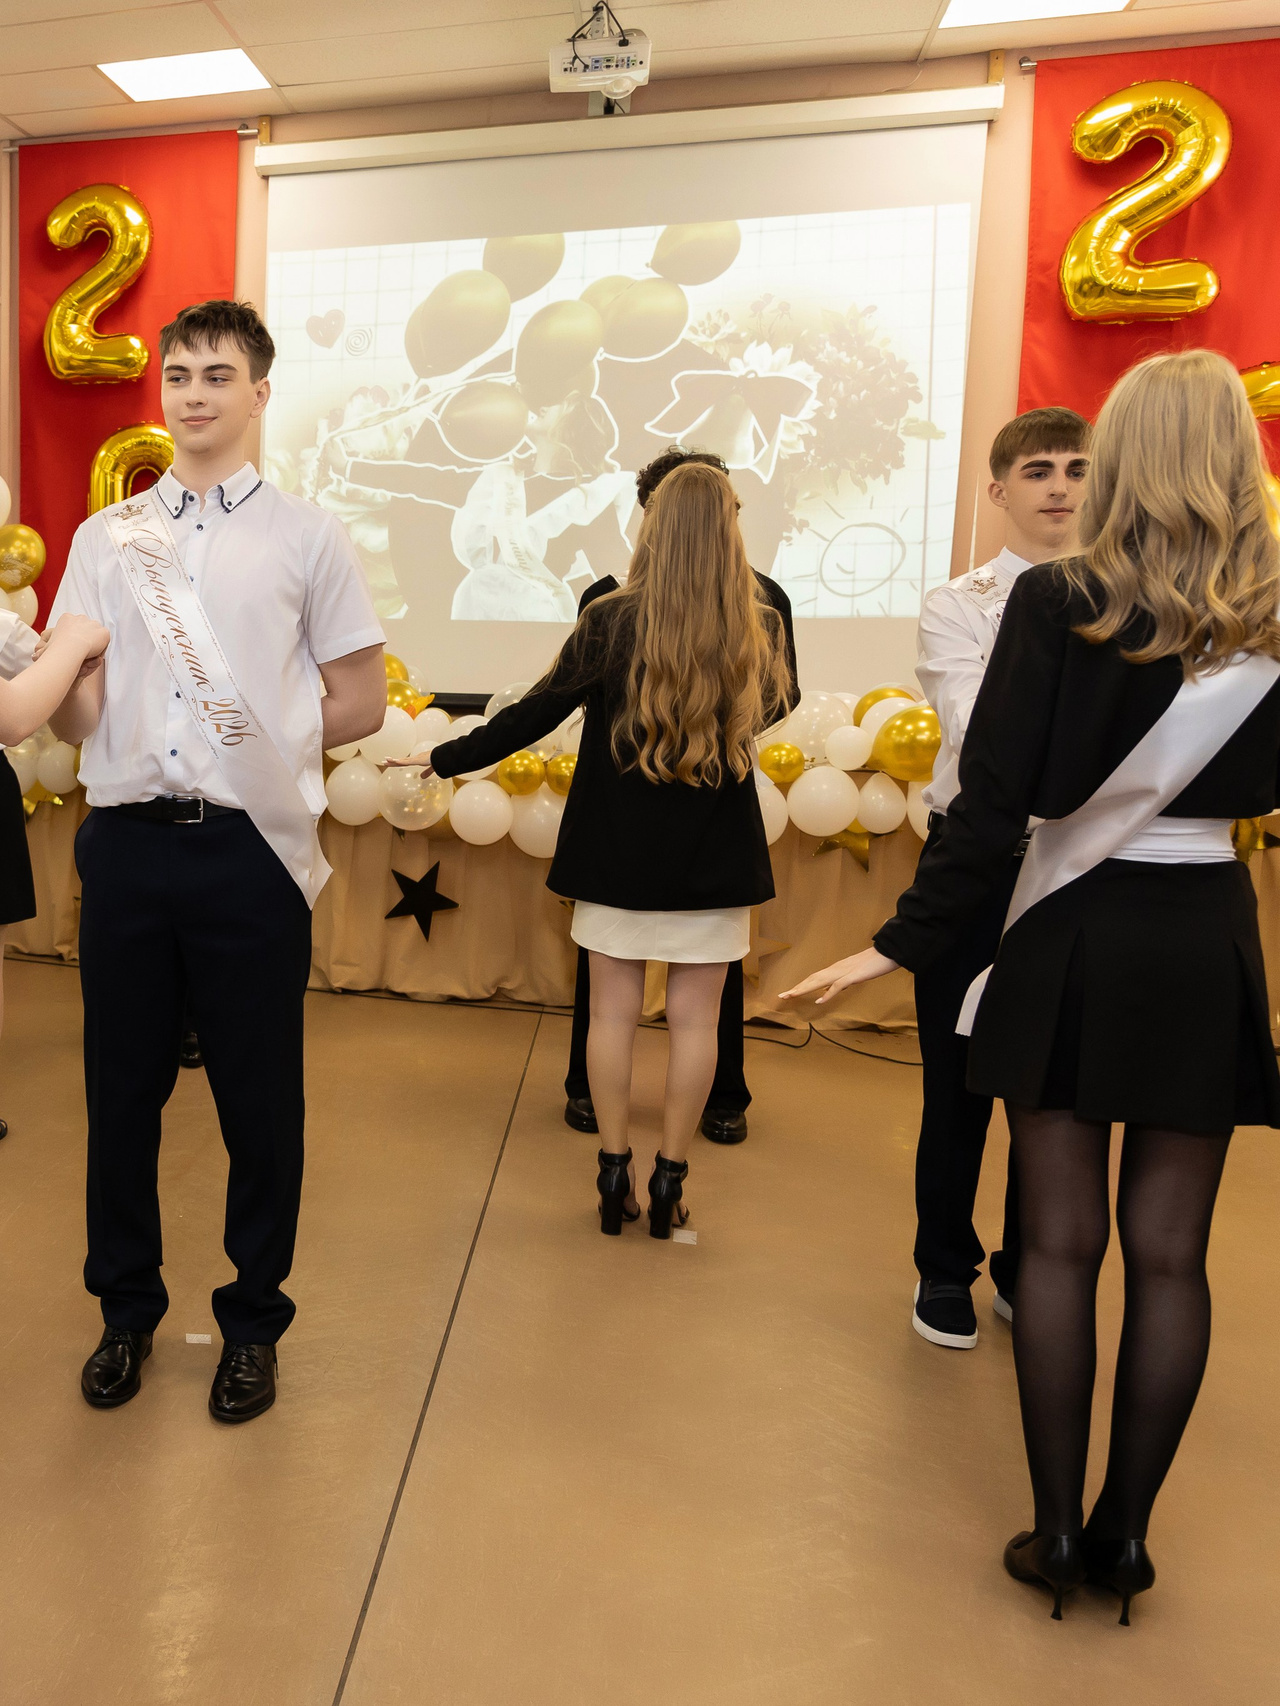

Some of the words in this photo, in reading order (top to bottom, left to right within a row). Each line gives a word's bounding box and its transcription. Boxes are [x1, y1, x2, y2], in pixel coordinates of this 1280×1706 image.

[43, 182, 154, 384] 2
[1057, 79, 1233, 324] 2
[126, 528, 215, 693] Выпускник
[199, 697, 258, 747] 2026
